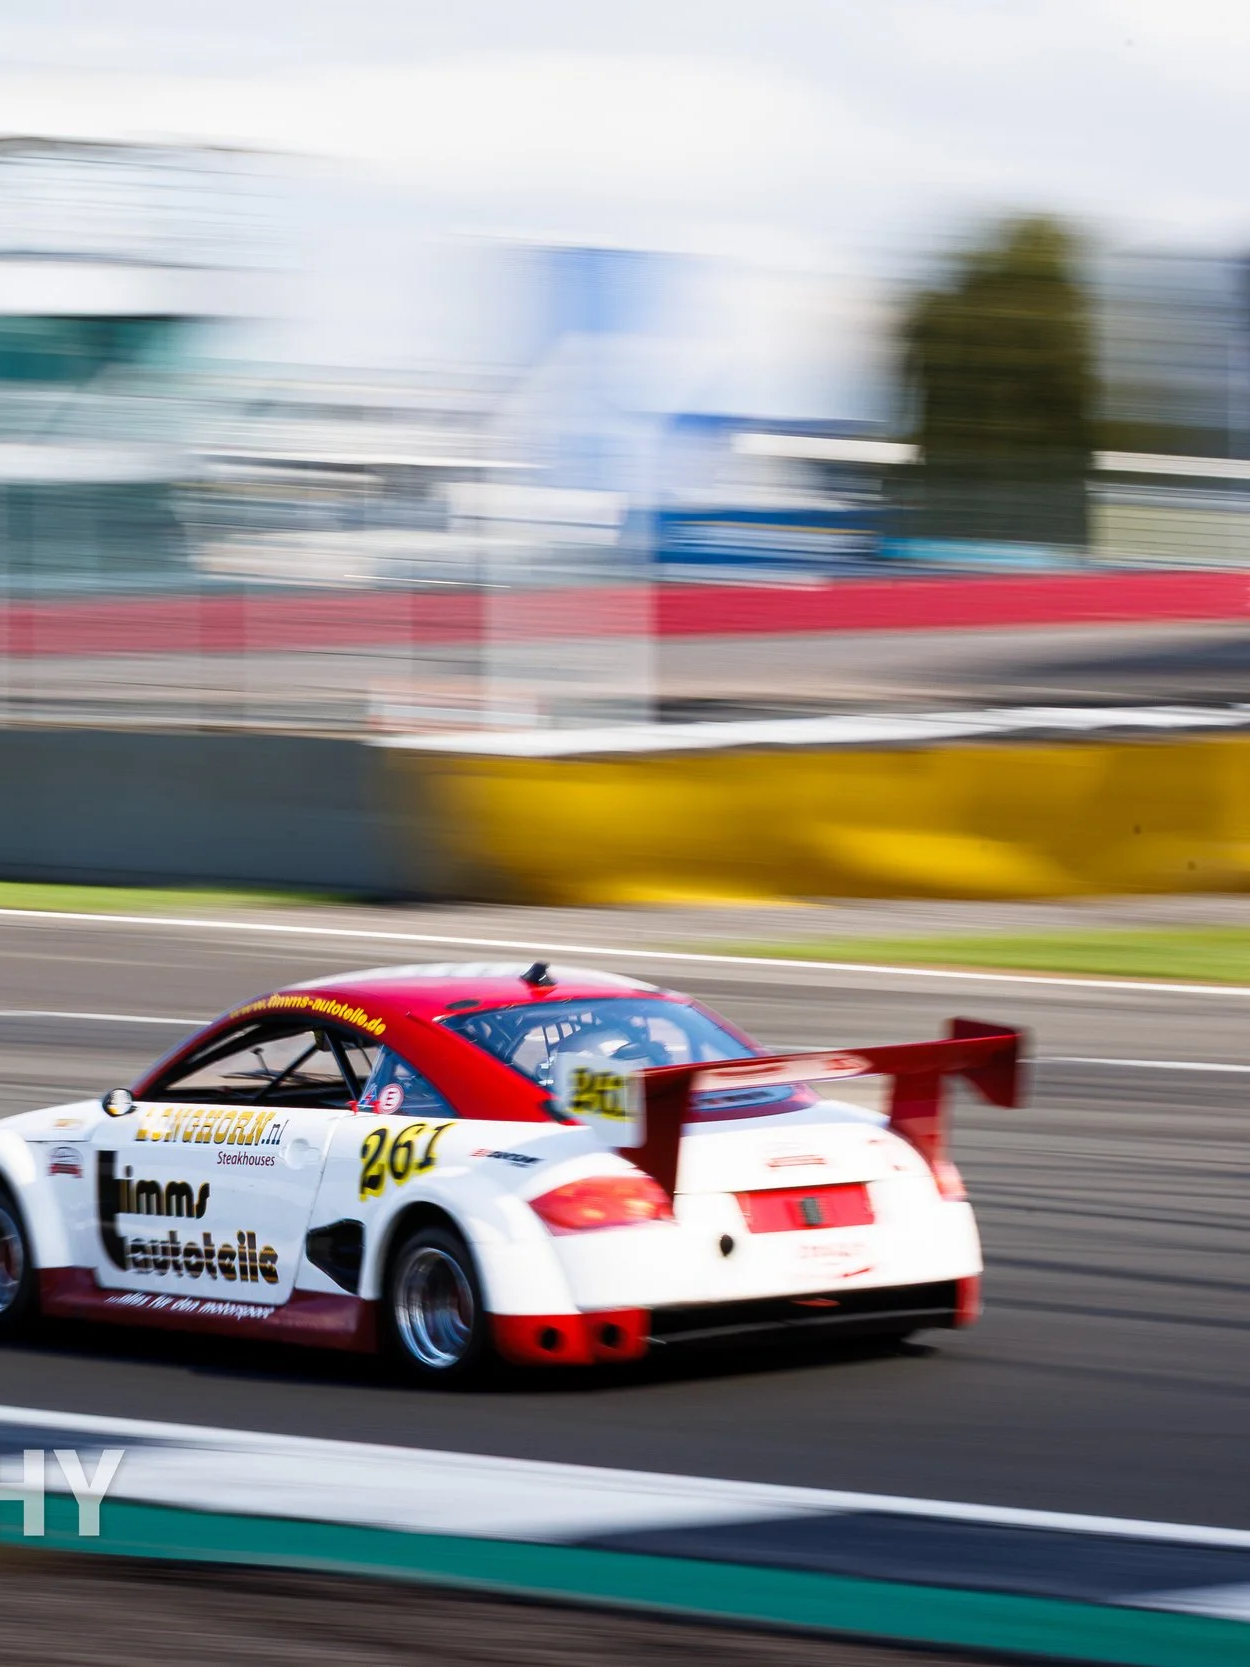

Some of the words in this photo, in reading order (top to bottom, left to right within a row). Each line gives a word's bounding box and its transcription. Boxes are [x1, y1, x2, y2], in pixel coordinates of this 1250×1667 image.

[217, 1151, 275, 1166] Steakhouses
[359, 1122, 457, 1203] 261
[97, 1150, 210, 1270] timms
[127, 1230, 279, 1284] autoteile
